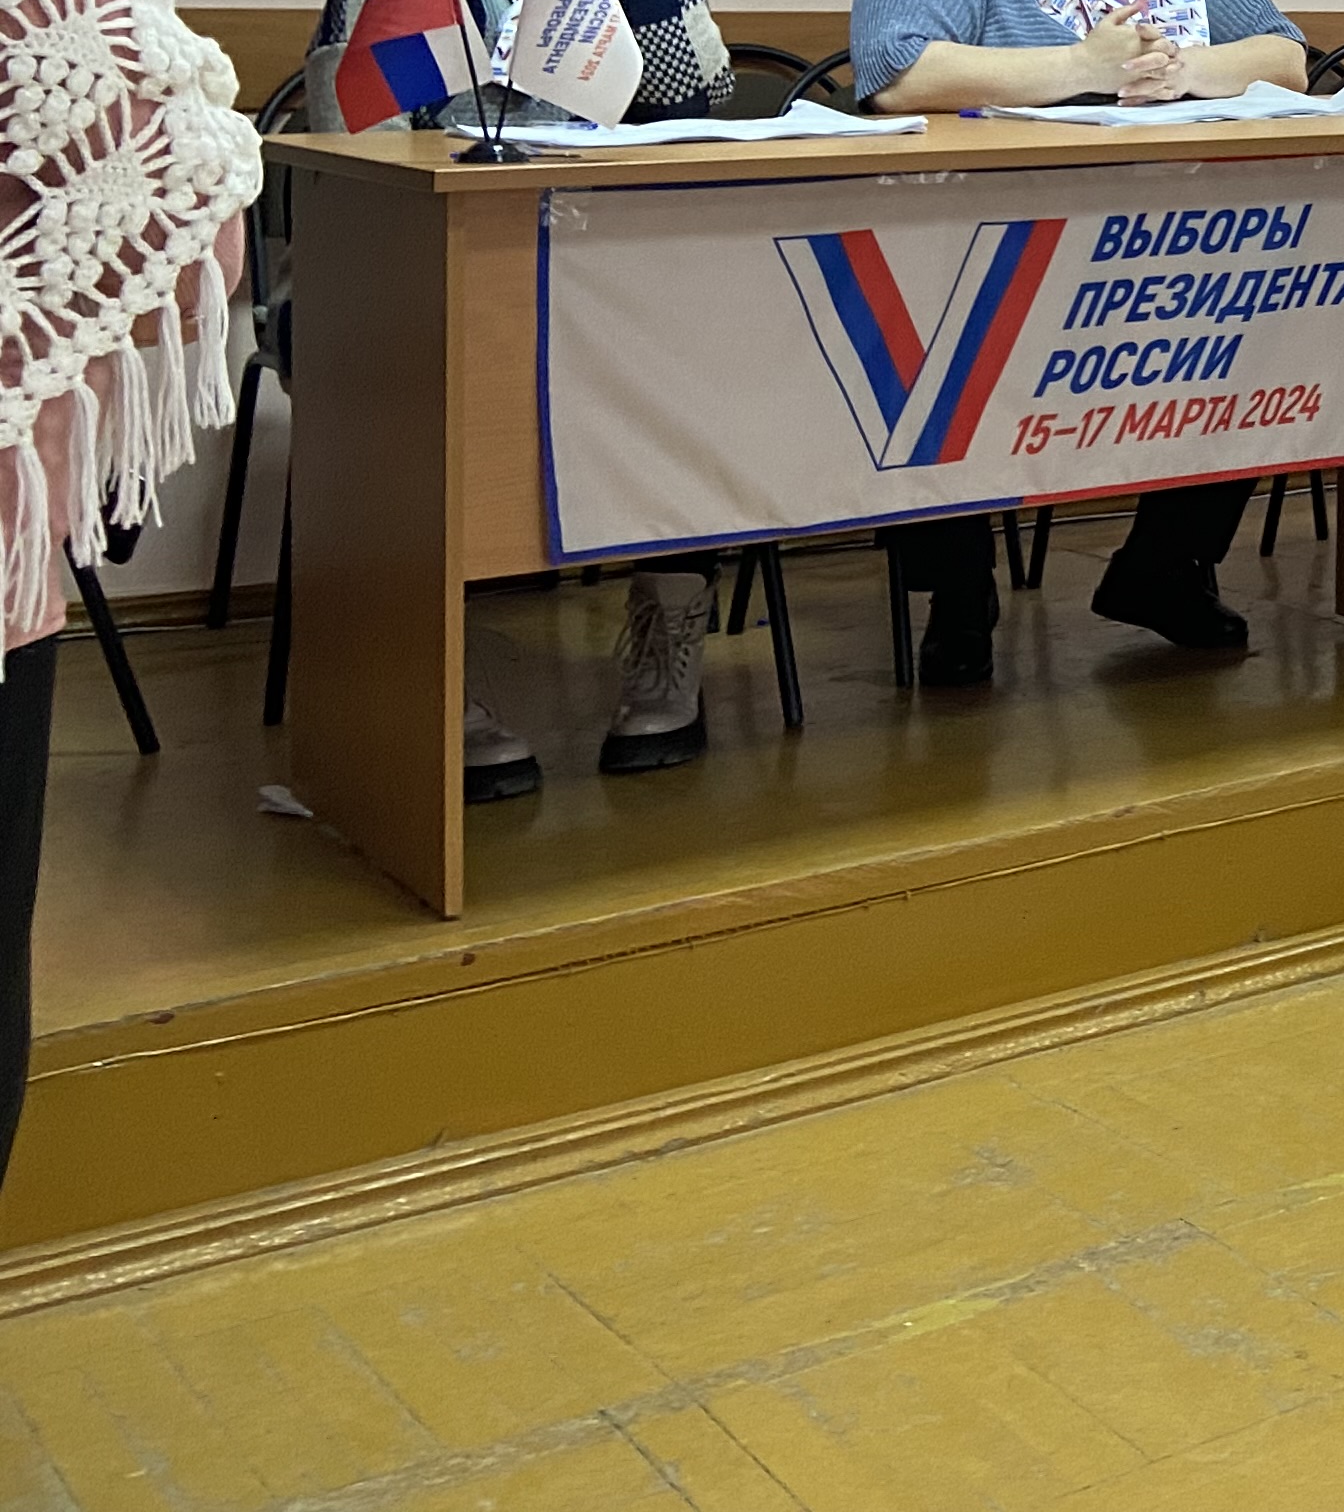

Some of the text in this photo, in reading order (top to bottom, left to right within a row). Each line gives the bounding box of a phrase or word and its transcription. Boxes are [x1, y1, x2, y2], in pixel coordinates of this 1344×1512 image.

[1090, 204, 1313, 262] ВЫБОРЫ
[1033, 334, 1244, 398] РОССИИ
[1114, 394, 1239, 445] МАРТА
[1238, 383, 1321, 430] 2024
